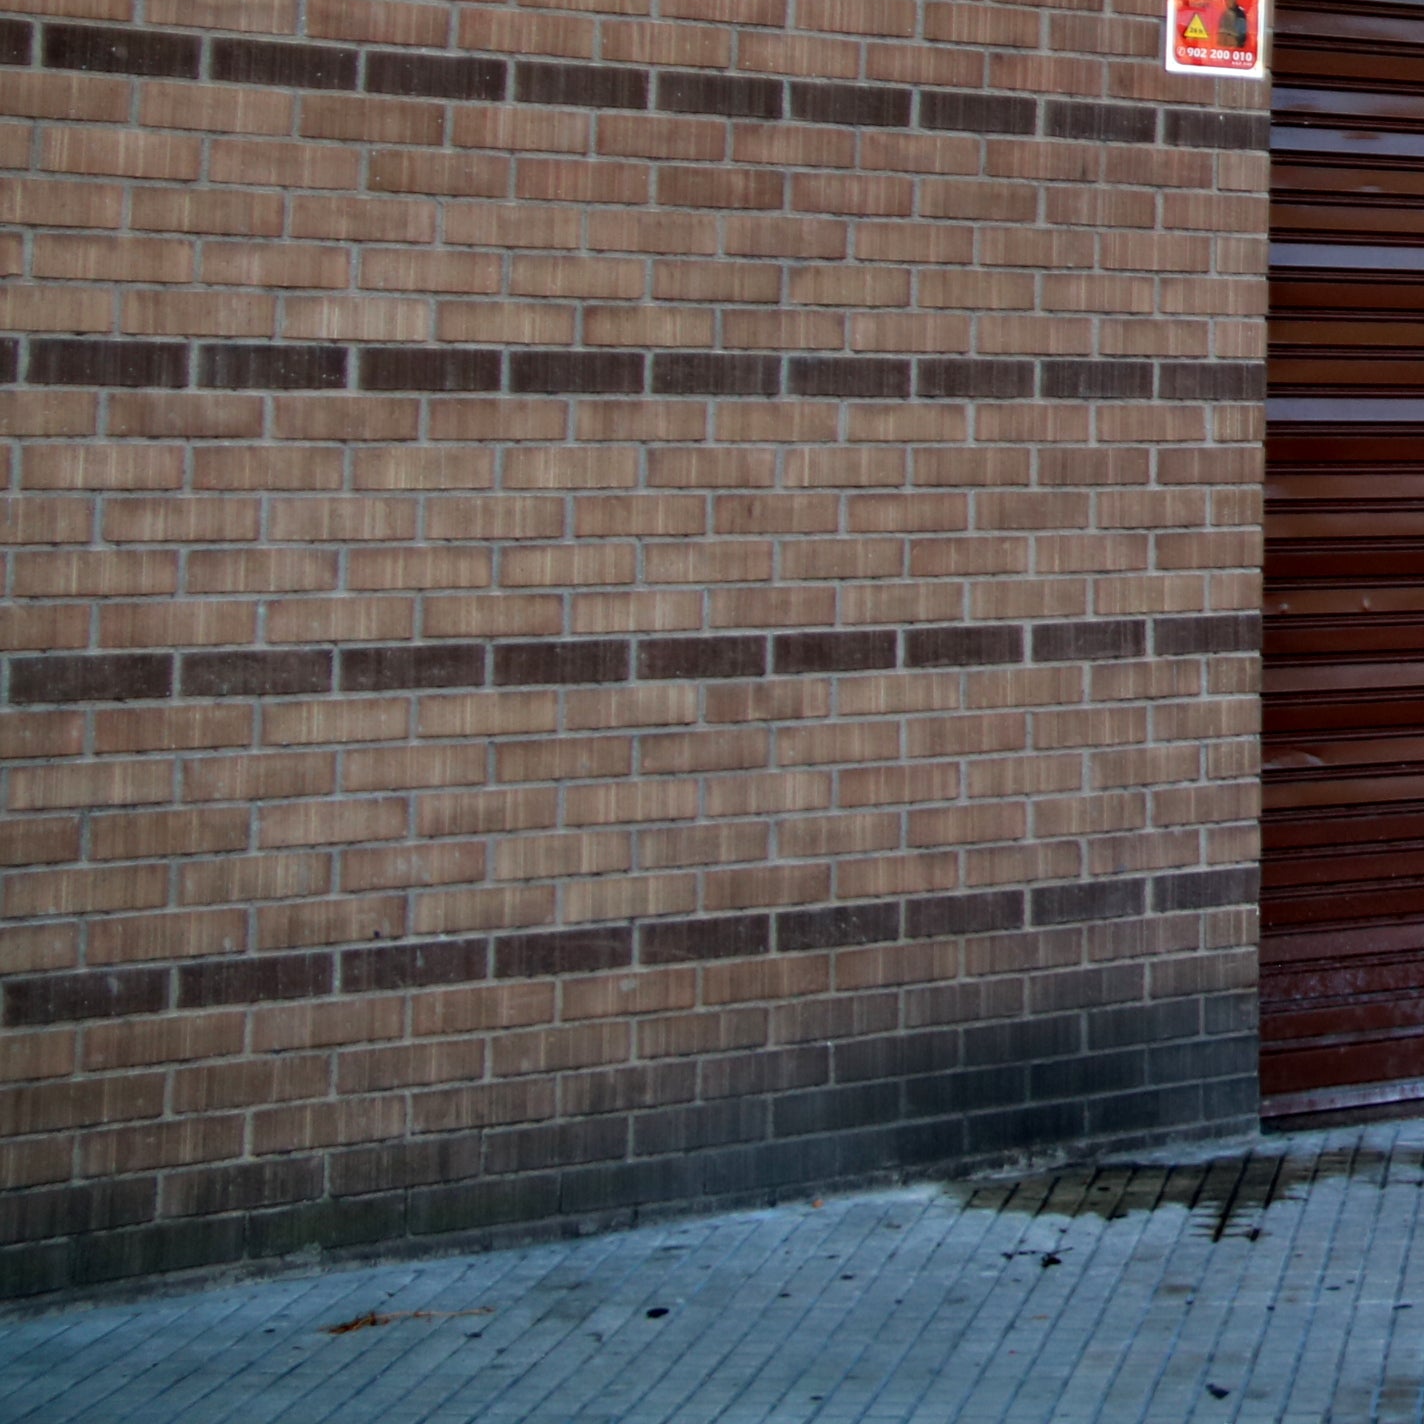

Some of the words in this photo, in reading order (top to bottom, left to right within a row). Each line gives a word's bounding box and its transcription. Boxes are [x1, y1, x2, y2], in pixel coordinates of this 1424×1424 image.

[1186, 46, 1208, 59] 902
[1209, 48, 1231, 60] 200
[1232, 50, 1254, 62] 010
